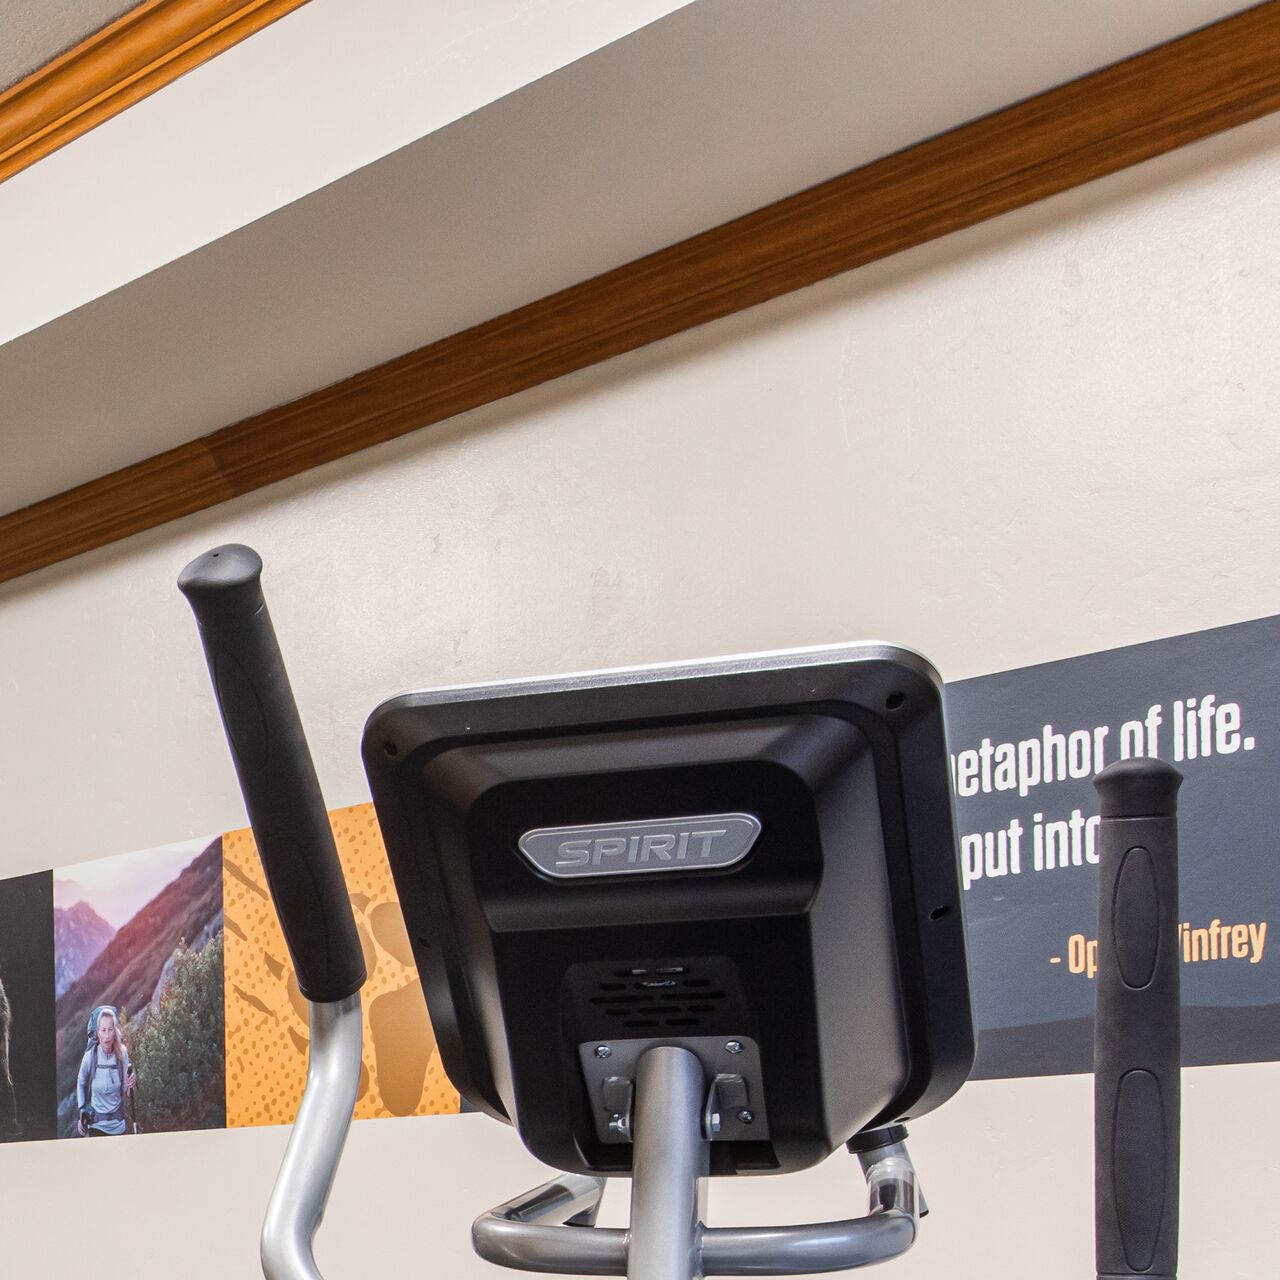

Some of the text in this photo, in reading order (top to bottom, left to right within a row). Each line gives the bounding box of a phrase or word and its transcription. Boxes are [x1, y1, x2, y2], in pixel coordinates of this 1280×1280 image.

[950, 694, 1255, 797] etaphor of life.
[556, 829, 726, 867] SPIRIT
[961, 819, 1023, 890] put
[1178, 919, 1267, 963] infrey
